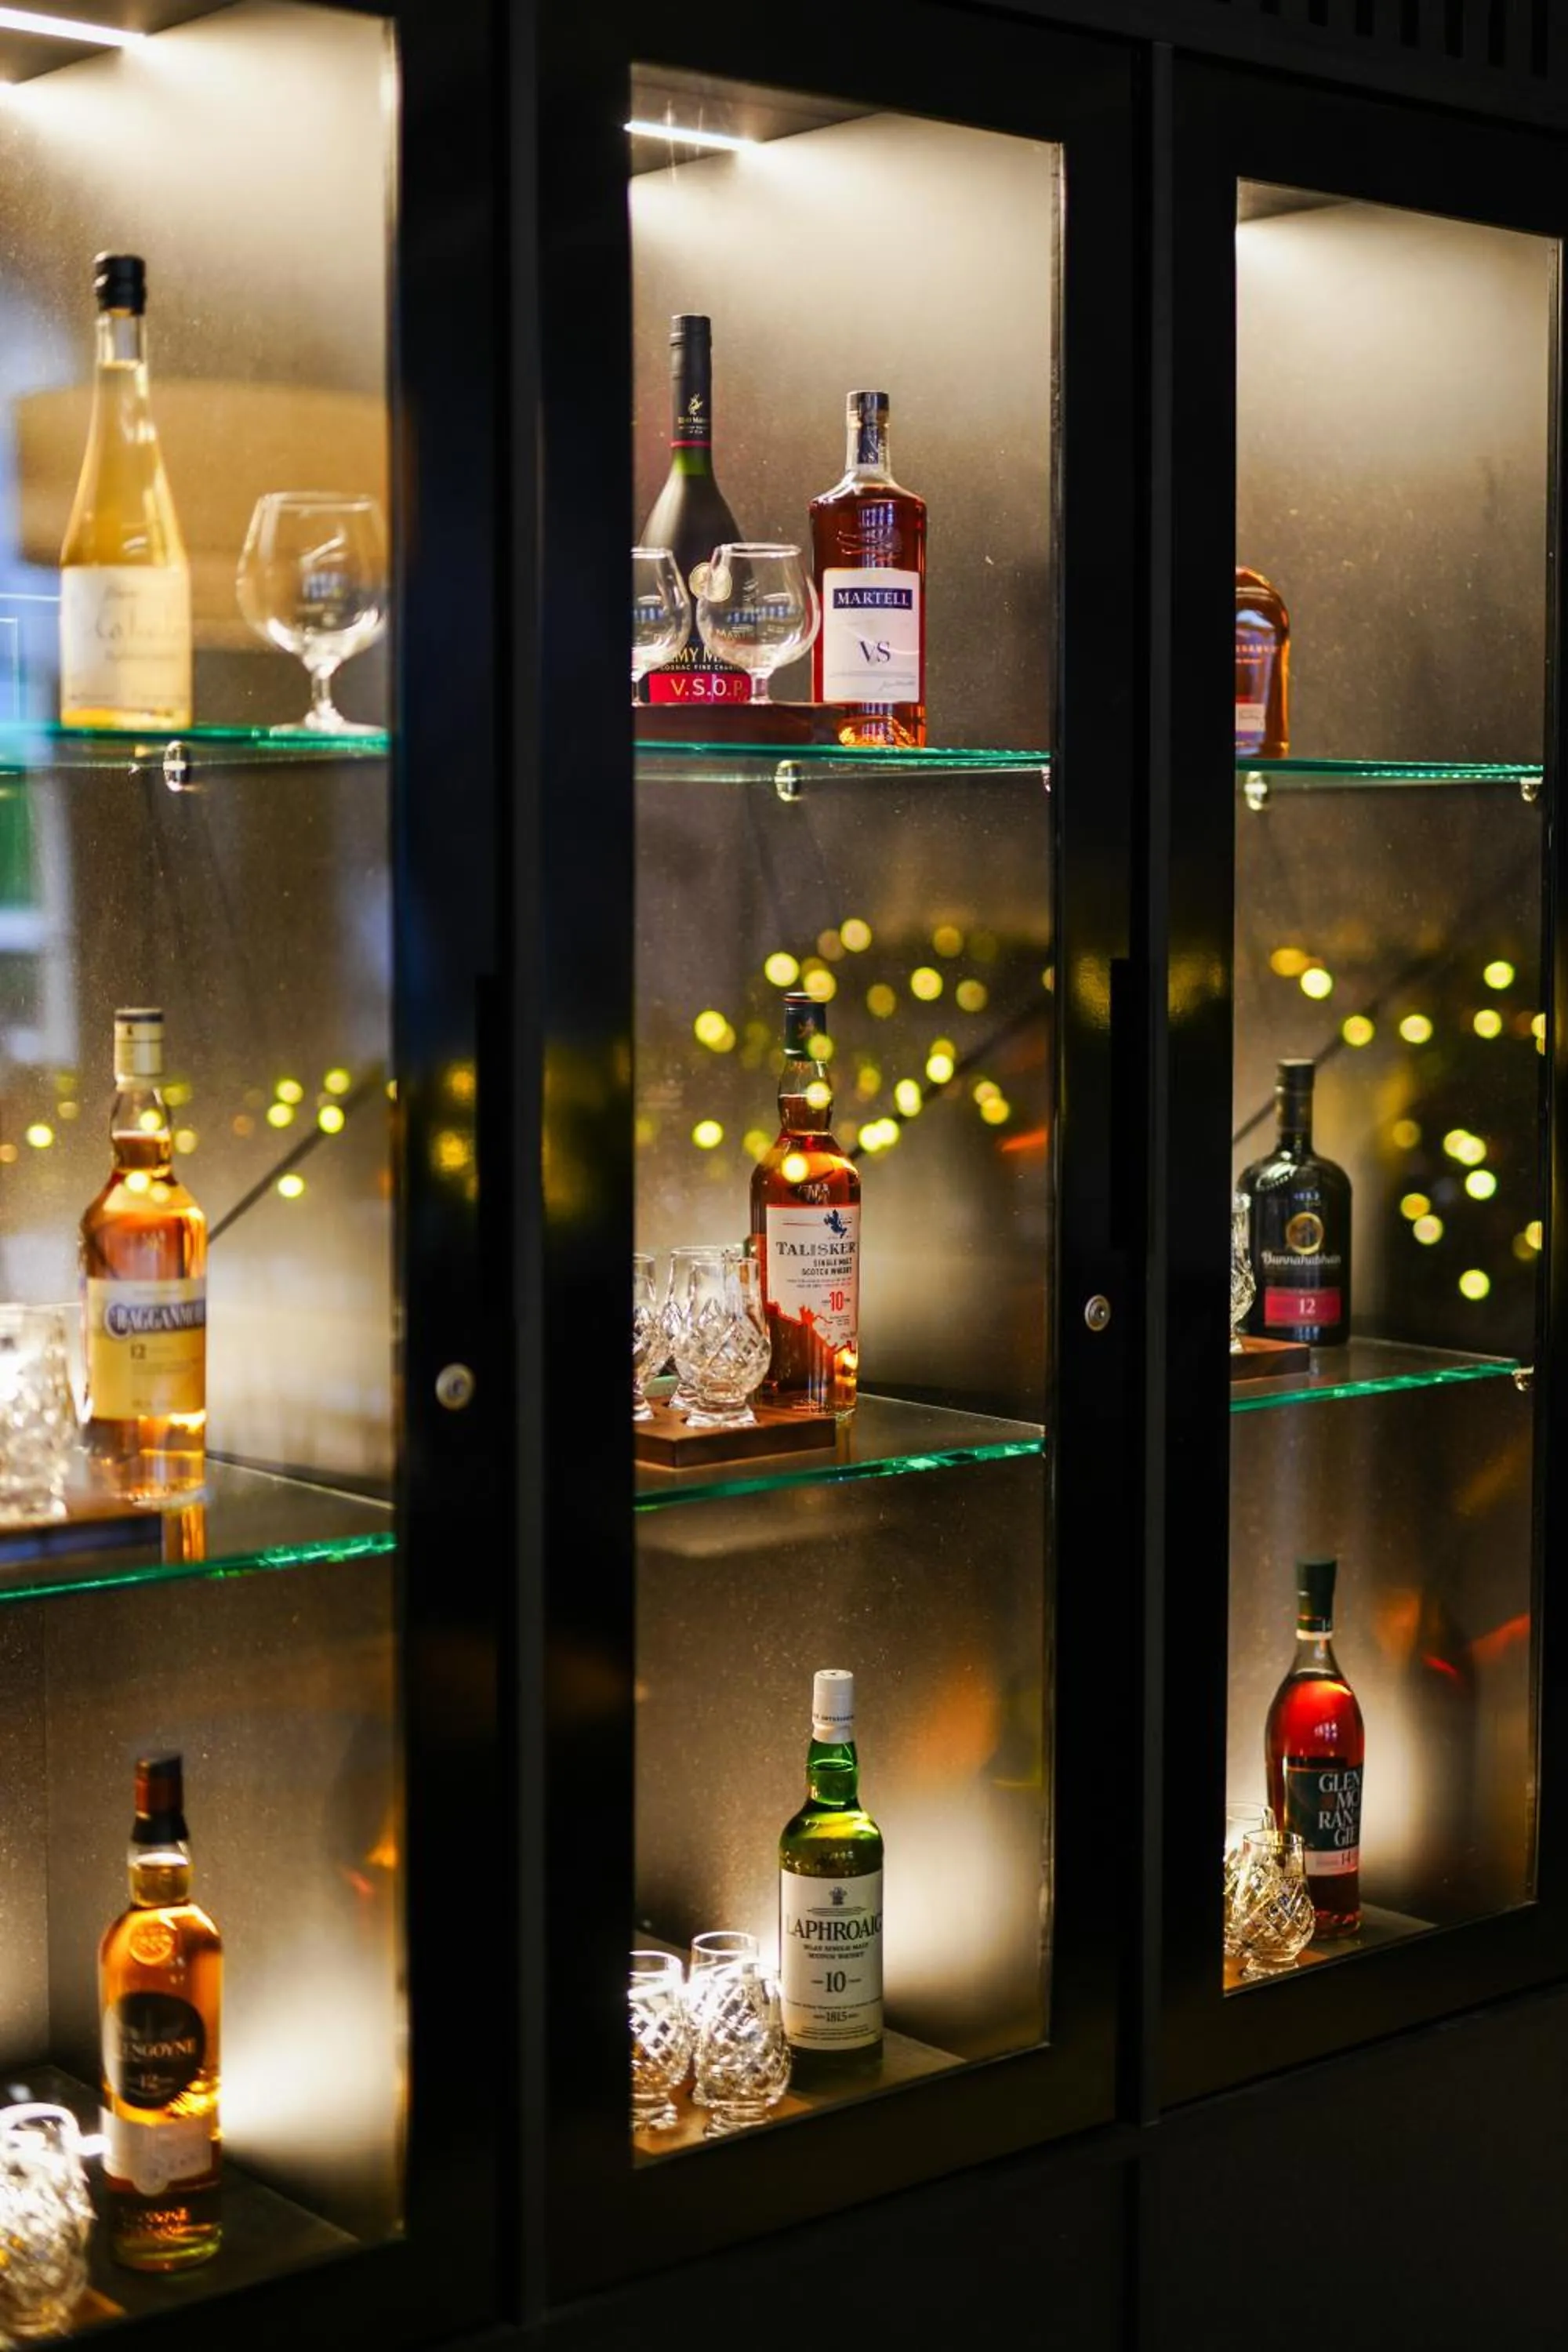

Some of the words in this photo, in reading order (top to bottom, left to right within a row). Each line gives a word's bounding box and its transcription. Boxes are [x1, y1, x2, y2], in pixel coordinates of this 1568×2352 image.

[837, 591, 909, 606] MARTELL
[859, 640, 891, 663] VS
[775, 1240, 856, 1257] TALISKER
[829, 1290, 844, 1312] 10
[1299, 1297, 1316, 1316] 12
[826, 1970, 847, 1994] 10
